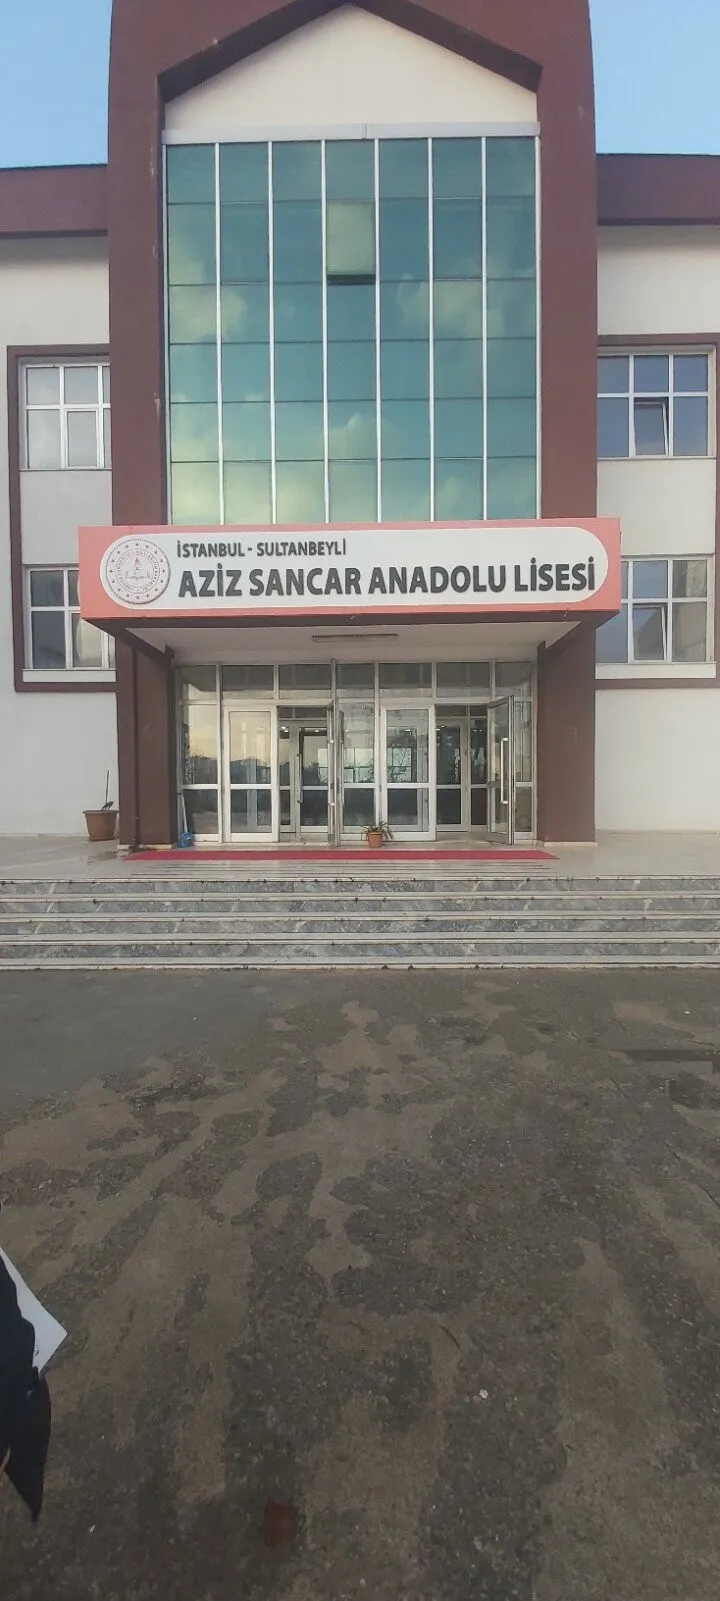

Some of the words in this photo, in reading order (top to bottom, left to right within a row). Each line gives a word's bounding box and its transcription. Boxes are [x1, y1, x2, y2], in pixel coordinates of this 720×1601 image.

[176, 540, 246, 558] İSTANBUL
[256, 538, 347, 557] SULTANBEYLİ
[178, 562, 243, 598] AZİZ
[248, 567, 362, 597] SANCAR
[367, 564, 507, 595] ANADOLU
[514, 556, 596, 593] LİSESİ
